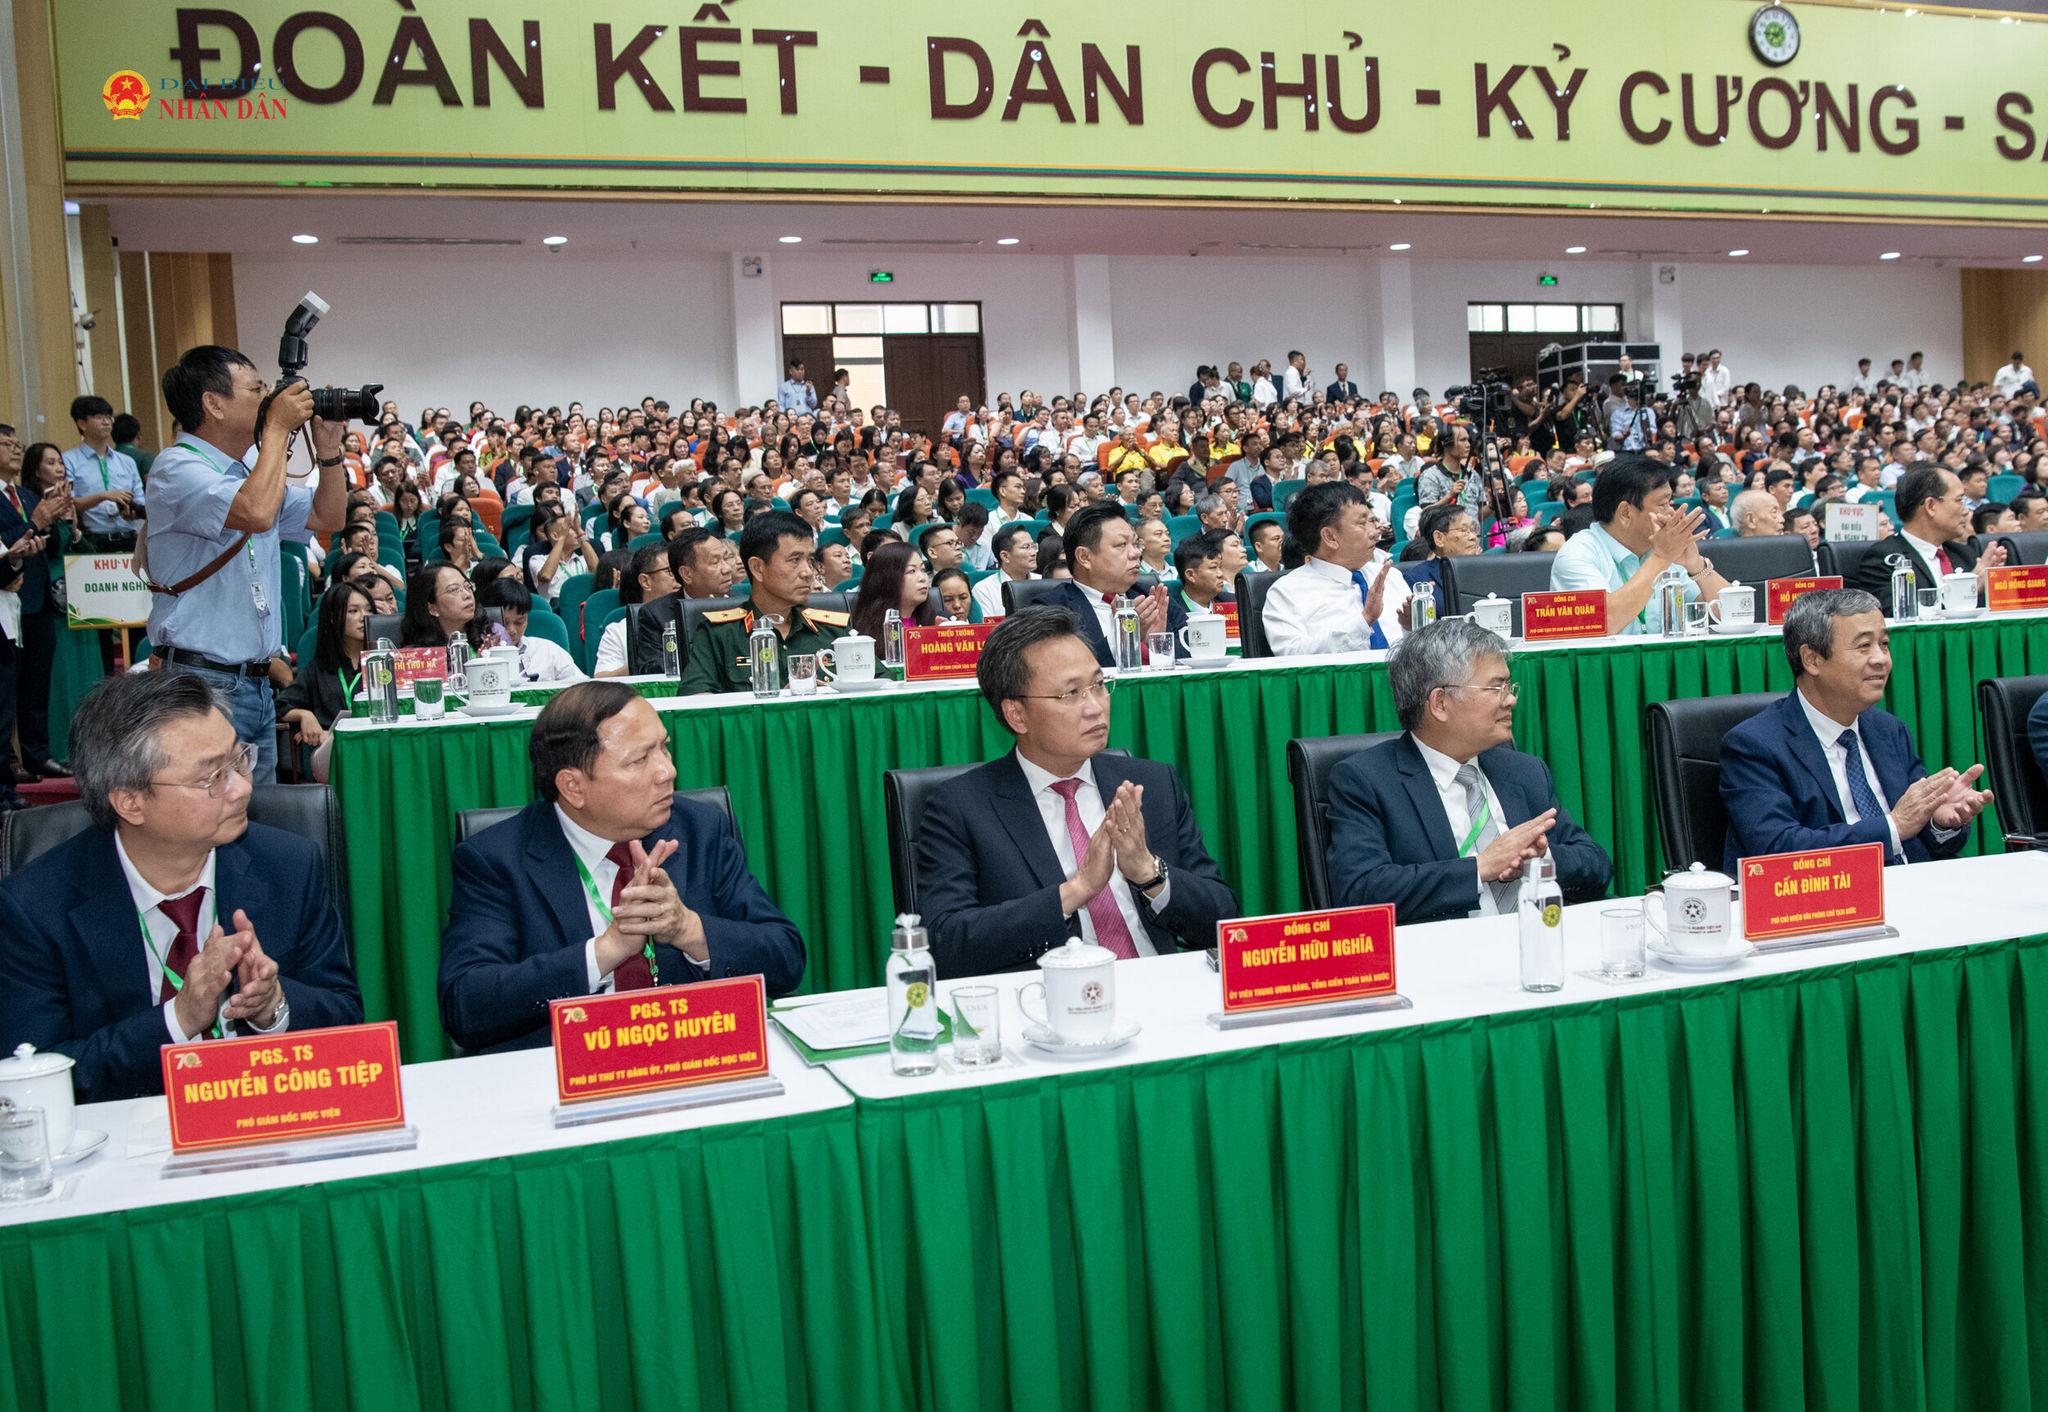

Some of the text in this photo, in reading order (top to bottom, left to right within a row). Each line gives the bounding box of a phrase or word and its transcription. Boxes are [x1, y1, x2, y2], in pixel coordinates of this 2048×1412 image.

[169, 0, 545, 109] ĐOÀN
[926, 19, 1144, 126] DÂN
[1191, 31, 1381, 134] CHỦ
[1474, 43, 1588, 141] KỶ
[1619, 70, 1920, 156] CƯƠNG
[1995, 91, 2048, 162] S
[94, 559, 118, 570] KHU
[84, 581, 150, 593] DOANH NGHI
[1553, 595, 1567, 603] ĐỒNG
[1535, 604, 1595, 617] TRẦN VĂN QUÂN
[937, 628, 974, 637] THIẾU TƯỚNG
[921, 641, 953, 654] HOÀNG
[955, 640, 974, 652] VĂN
[1793, 855, 1831, 870] ĐỒNG CHÍ
[1801, 874, 1830, 894] ĐÌNH
[1833, 871, 1851, 889] TÀI
[1283, 918, 1331, 936] ĐỒNG CHÍ
[1241, 933, 1374, 968] NGUYỄN HỮU NGHĨA
[630, 998, 689, 1020] PGS. TS
[583, 1010, 737, 1051] VŨ NGỌC HUYÊN
[249, 1044, 314, 1068] PGS. TS
[184, 1060, 383, 1104] NGUYỄN CÔNG TIỆP
[616, 1070, 626, 1080] TT
[236, 1106, 341, 1129] PHÓ GIÁM ĐỐC HỌC VIỆN
